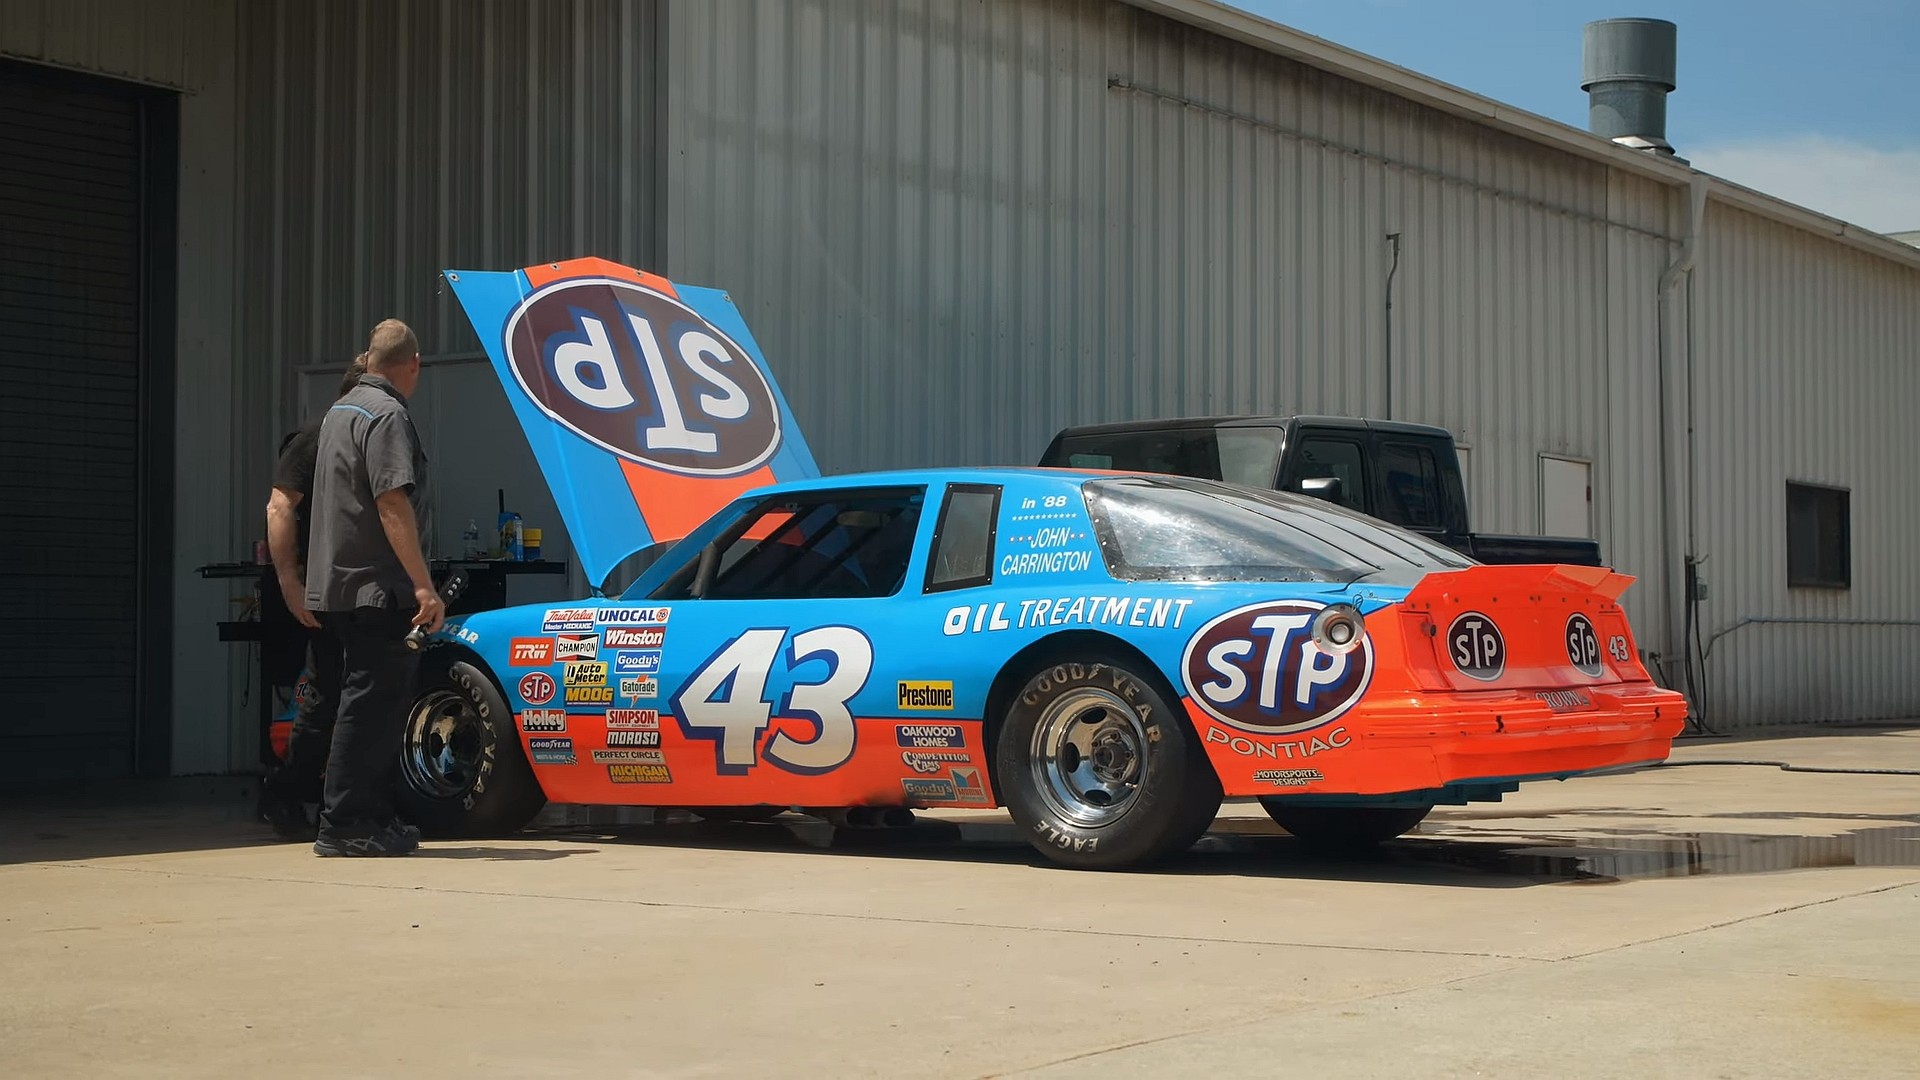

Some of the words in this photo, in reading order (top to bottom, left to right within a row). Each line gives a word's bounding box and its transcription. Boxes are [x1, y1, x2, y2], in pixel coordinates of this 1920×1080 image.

[554, 313, 750, 453] STP
[1021, 497, 1036, 509] in
[1030, 527, 1071, 548] JOHN
[1001, 551, 1092, 576] CARRINGTON
[598, 609, 656, 622] UNOCAL
[942, 602, 1011, 636] OIL
[1017, 596, 1193, 629] TREATMENT
[605, 629, 664, 645] Winston
[1570, 622, 1596, 666] STP
[514, 643, 550, 659] TRW
[558, 642, 596, 653] CHAMPION
[1456, 621, 1497, 669] STP
[1608, 635, 1629, 661] 43
[577, 664, 602, 673] Auto
[618, 655, 660, 669] Goody's
[1201, 613, 1350, 712] STP
[574, 674, 605, 684] Meter
[622, 681, 656, 692] Gatorade
[523, 676, 551, 698] STP
[565, 687, 614, 702] MOOG
[898, 683, 952, 706] Prestone
[670, 625, 874, 774] 43
[523, 710, 565, 730] Holley
[609, 710, 656, 724] SIMPSON
[607, 731, 659, 745] MOROSO
[901, 726, 957, 737] OAKWOOD
[912, 737, 949, 747] HOMES
[1205, 726, 1352, 760] PONTIAC
[594, 751, 629, 759] PERFECT
[630, 751, 661, 759] CIRCLE
[609, 765, 669, 776] MICHIGAN
[1256, 769, 1318, 778] MOTORSPORTS
[1273, 777, 1306, 786] DESIGNS
[1033, 819, 1099, 853] EAGLE
